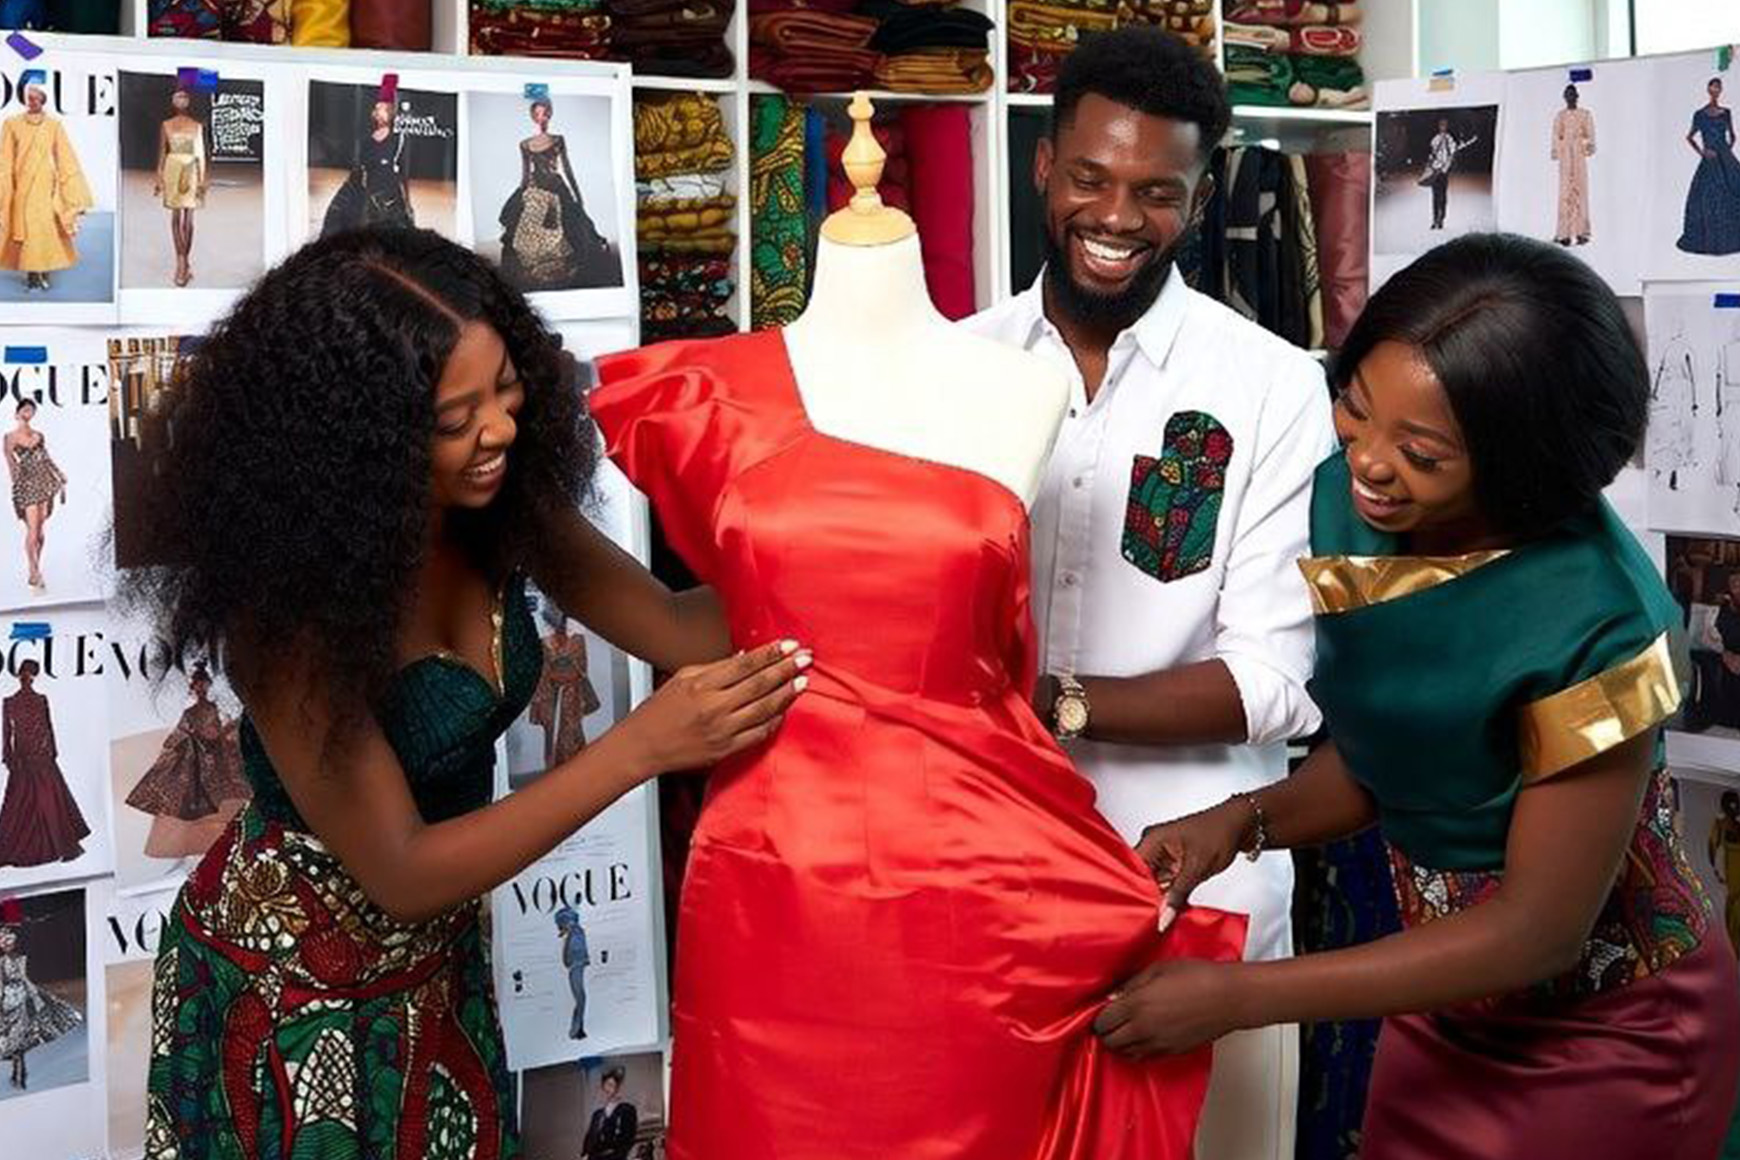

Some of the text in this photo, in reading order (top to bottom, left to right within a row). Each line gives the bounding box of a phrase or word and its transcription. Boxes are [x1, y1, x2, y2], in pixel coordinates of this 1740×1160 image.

[0, 365, 107, 407] GUE
[0, 632, 103, 680] GUE
[512, 863, 631, 915] VOGUE
